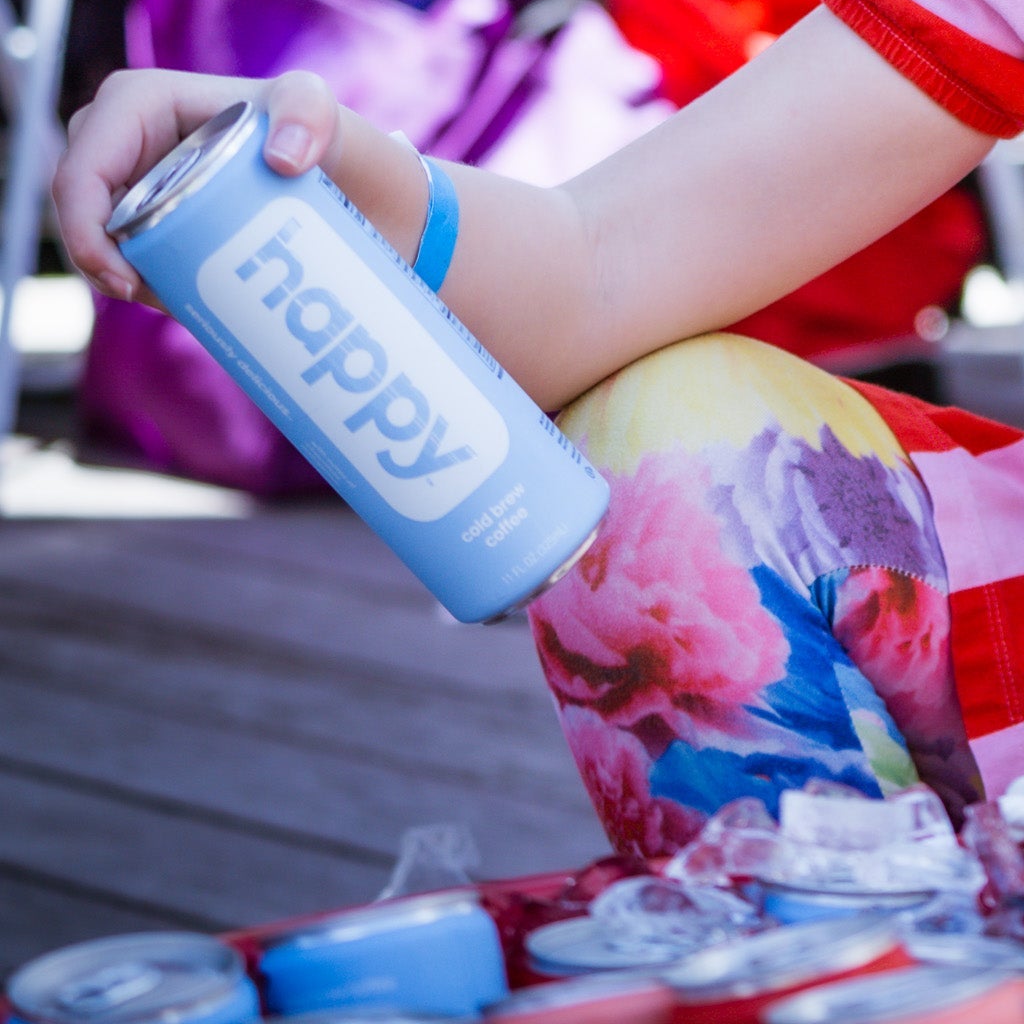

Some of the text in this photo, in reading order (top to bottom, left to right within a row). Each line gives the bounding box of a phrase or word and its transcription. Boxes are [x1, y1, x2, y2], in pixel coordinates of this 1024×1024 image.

[235, 217, 479, 479] happy
[461, 482, 525, 543] cold brew
[485, 507, 528, 547] coffee
